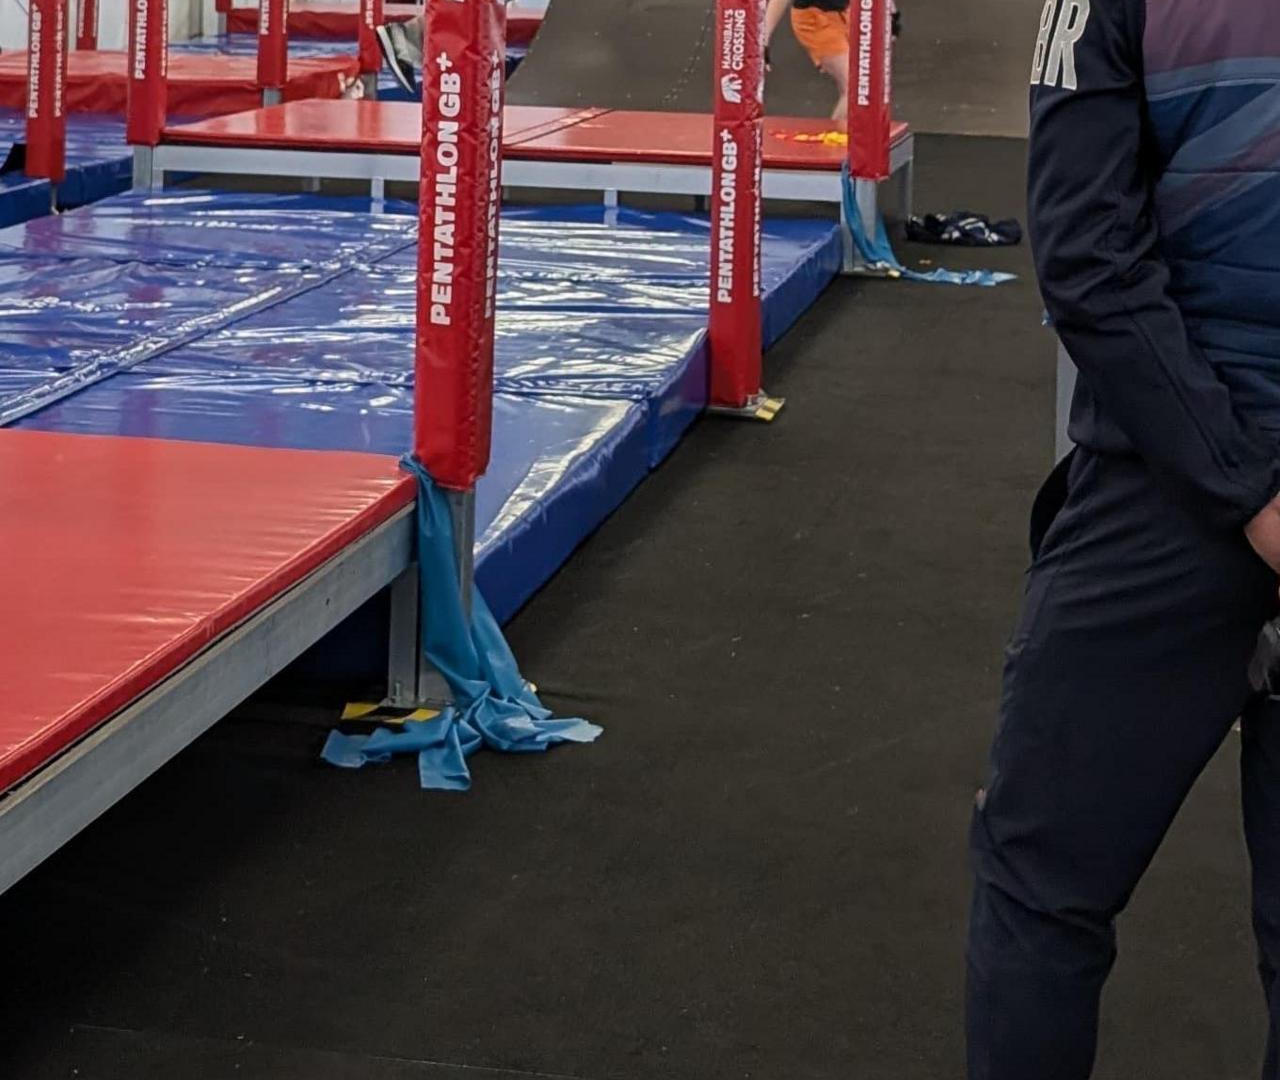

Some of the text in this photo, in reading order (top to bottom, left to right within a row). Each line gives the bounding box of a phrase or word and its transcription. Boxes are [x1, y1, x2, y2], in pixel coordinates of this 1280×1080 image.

[29, 32, 40, 118] PENTATHLON
[721, 9, 734, 69] HANNIBAL'S
[731, 8, 746, 71] CROSSING
[857, 11, 872, 106] PENTATHLON
[430, 120, 459, 325] PENTATHLON
[484, 117, 499, 318] PENTATHLON
[717, 172, 736, 303] PENTATHLON
